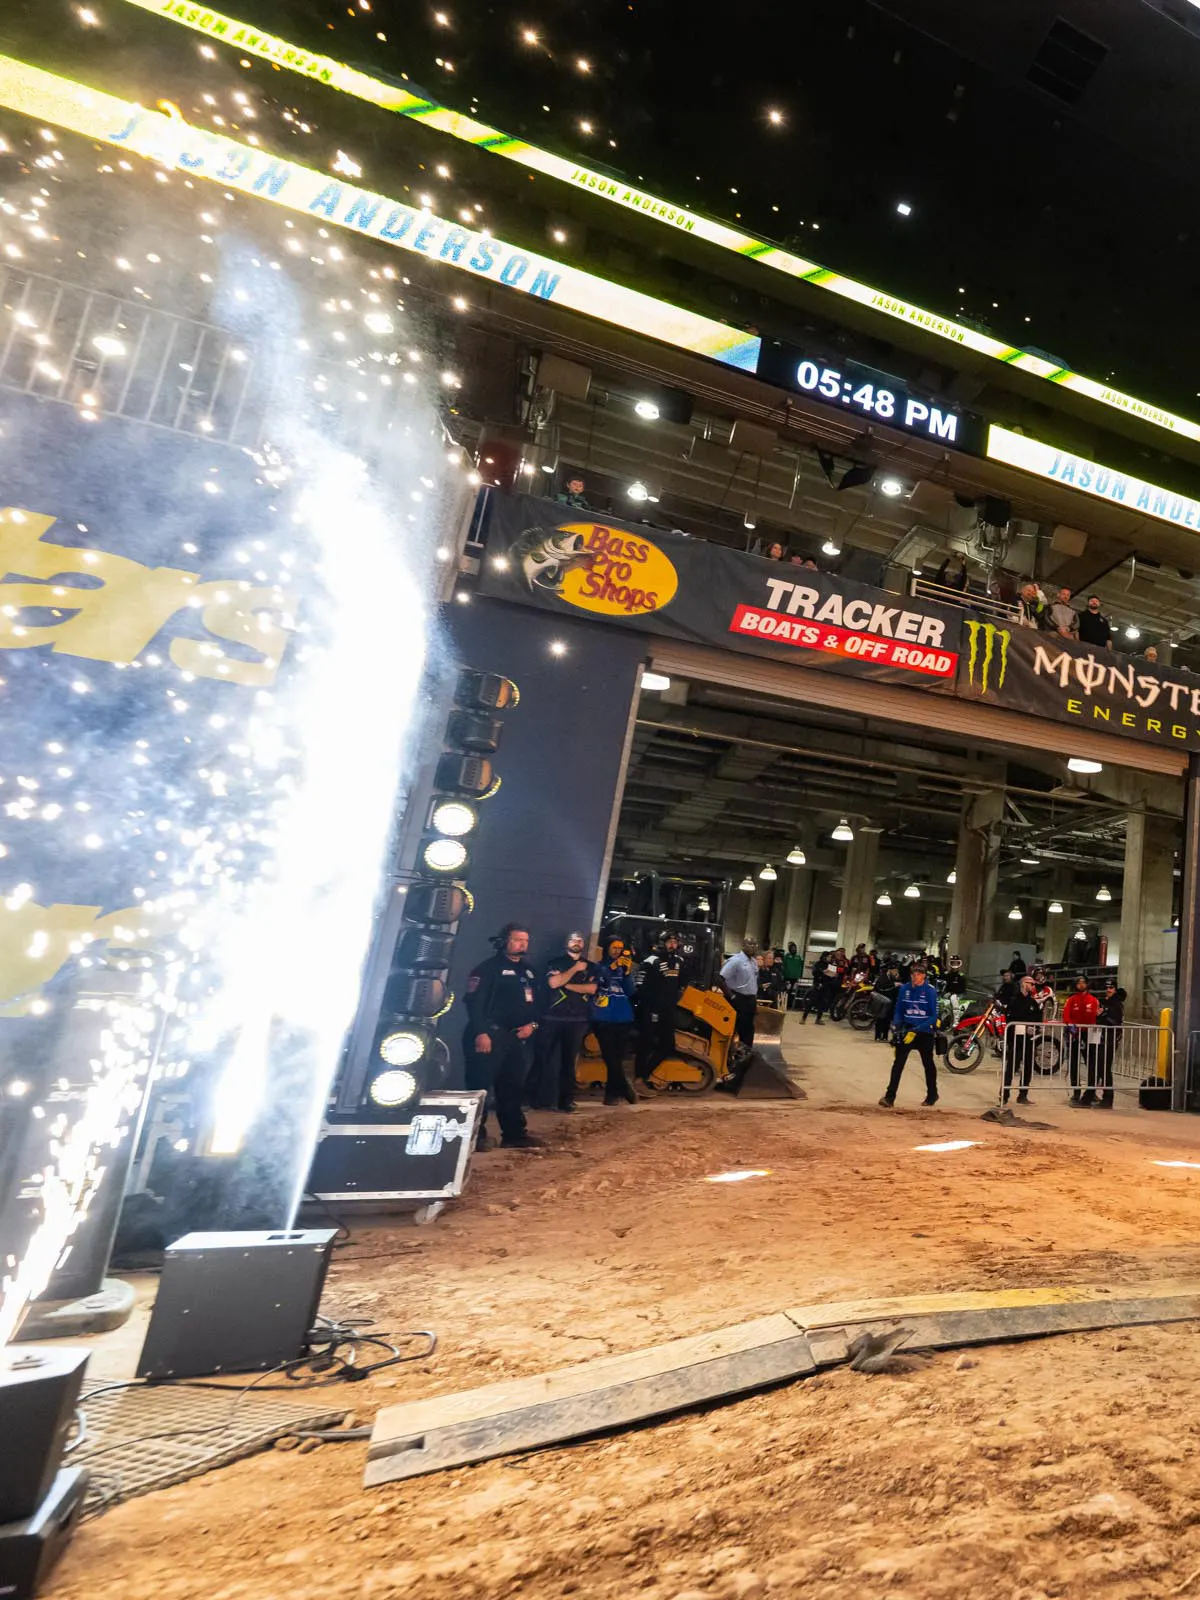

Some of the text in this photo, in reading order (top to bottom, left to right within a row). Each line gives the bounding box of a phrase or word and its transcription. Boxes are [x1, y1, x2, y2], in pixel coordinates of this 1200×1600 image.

[161, 2, 228, 35] JASON
[108, 112, 562, 300] JSON ANDERSON
[569, 167, 696, 232] JASON ANDERSON
[871, 294, 966, 342] JASON ANDERSON
[796, 360, 958, 442] 05:48 PM
[1100, 389, 1176, 429] JASON ANDERSON
[1048, 451, 1127, 501] JASON
[583, 525, 650, 563] Bass
[585, 552, 632, 583] Pro
[579, 572, 657, 612] Shops
[766, 577, 946, 648] TRACKER
[739, 612, 952, 674] BOATS & OFF ROAD
